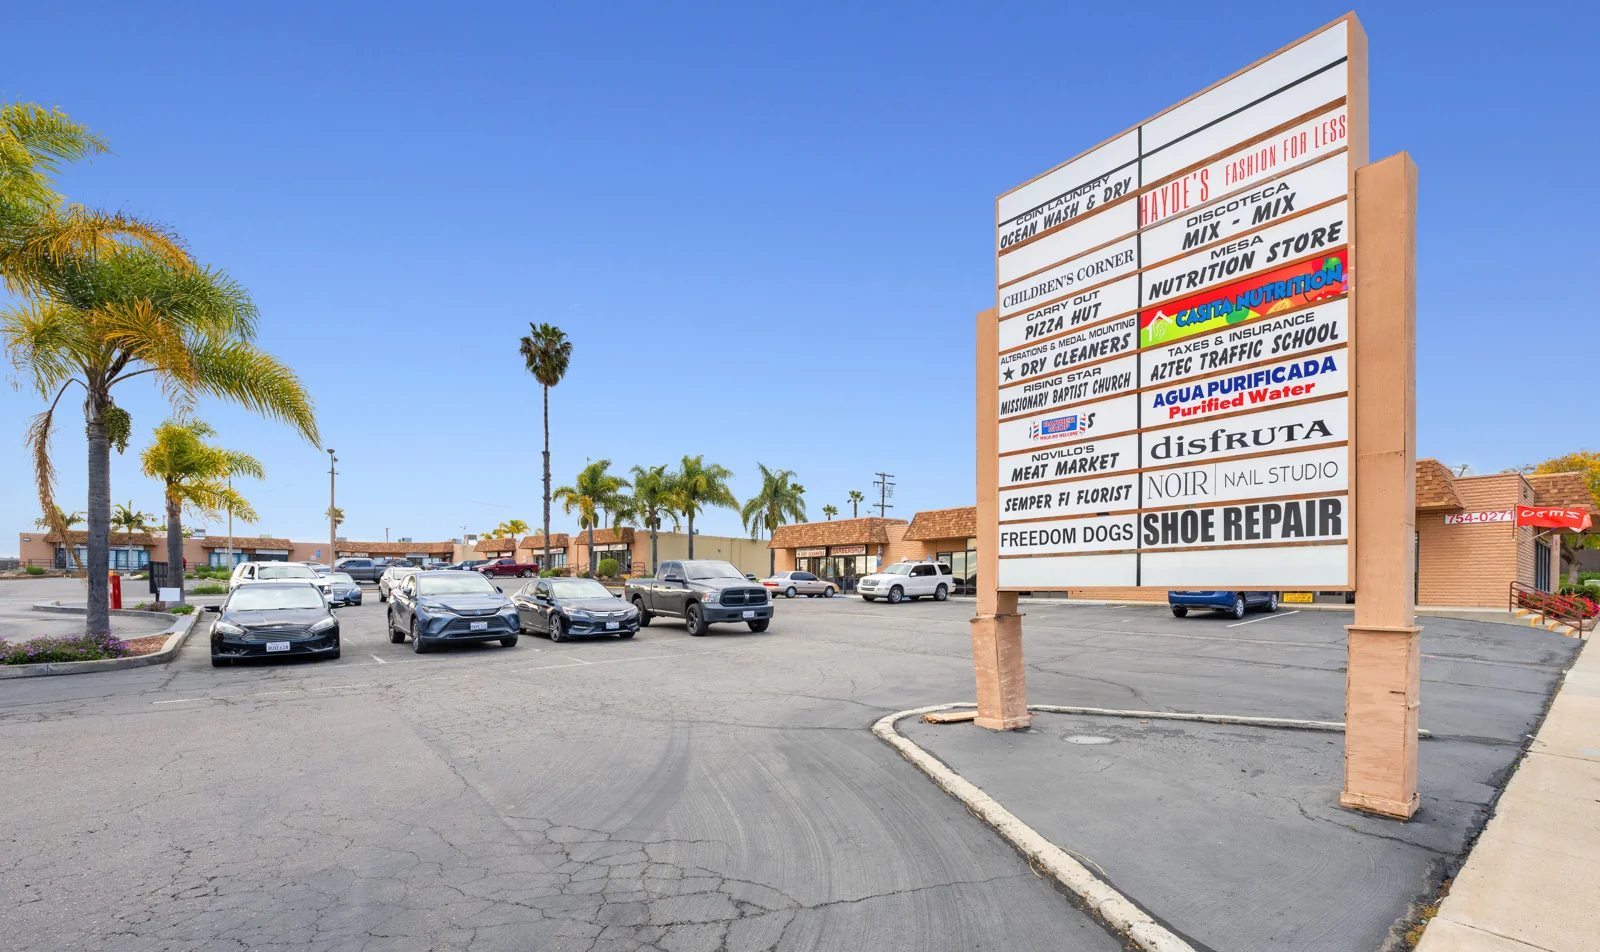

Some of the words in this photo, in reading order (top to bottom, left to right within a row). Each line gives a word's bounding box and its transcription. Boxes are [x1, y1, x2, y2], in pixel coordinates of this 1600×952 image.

[1139, 168, 1209, 227] HAYDE'S
[1225, 144, 1276, 186] FASHION
[1283, 131, 1307, 162] FOR
[1315, 114, 1346, 149] LESS
[1000, 221, 1038, 249] OCEAN
[1044, 199, 1079, 229] WASH
[1086, 194, 1095, 211] &
[1103, 176, 1132, 203] DRY
[1016, 208, 1044, 226] COIN
[1047, 175, 1110, 211] LAUNDRY
[1182, 220, 1221, 251] MIX
[1251, 192, 1296, 226] MIX
[1186, 182, 1290, 228] DISCOTECA
[1148, 250, 1256, 301] NUTRITION
[1266, 220, 1343, 263] STORE
[1210, 235, 1264, 260] MESA
[1003, 272, 1074, 308] CHILDREN'S
[1076, 249, 1134, 281] CORNER
[1175, 296, 1233, 328] CASITA
[1235, 263, 1343, 312] NUTRITION
[1025, 315, 1063, 340] PIZZA
[1071, 302, 1102, 326] HUT
[1026, 301, 1069, 321] CARRY
[1073, 290, 1100, 306] OUT
[1000, 344, 1048, 365] ALTERATIONS
[1050, 342, 1056, 351] &
[1058, 334, 1086, 348] MEDAL
[1089, 318, 1135, 339] MOUNTING
[1020, 356, 1047, 377] DRY
[1053, 332, 1131, 368] CLEANERS
[1150, 356, 1193, 382] AZTEC
[1200, 339, 1263, 370] TRAFFIC
[1271, 320, 1339, 355] SCHOOL
[1168, 339, 1209, 357] TAXES
[1214, 336, 1224, 346] &
[1229, 311, 1315, 342] INSURANCE
[1000, 391, 1049, 415] MISSIONARY
[1052, 382, 1088, 404] BAPTIST
[1092, 371, 1131, 394] CHURCH
[1023, 377, 1063, 393] RISING
[1067, 367, 1102, 383] STAR
[1152, 384, 1205, 408] AGUA
[1207, 355, 1338, 397] PURIFICADA
[1169, 392, 1244, 419] Purified
[1247, 382, 1315, 405] Water
[1043, 416, 1075, 428] BARBER
[1048, 423, 1070, 433] SHOP
[1011, 463, 1048, 482] MEAT
[1055, 452, 1120, 476] MARKET
[1031, 444, 1095, 462] NOVILLO'S
[1005, 493, 1052, 512] SEMPER
[1058, 491, 1070, 507] FI
[1076, 484, 1132, 505] FLORIST
[1147, 470, 1209, 500] NOIR
[1224, 469, 1264, 488] NAIL
[1268, 461, 1339, 484] STUDIO
[1001, 527, 1076, 547] FREEDOM
[1083, 523, 1133, 543] DOGS
[1143, 508, 1215, 546] SHOE
[1223, 498, 1342, 541] REPAIR
[1449, 511, 1513, 524] 754-0271
[832, 546, 865, 554] BARBERSHOP
